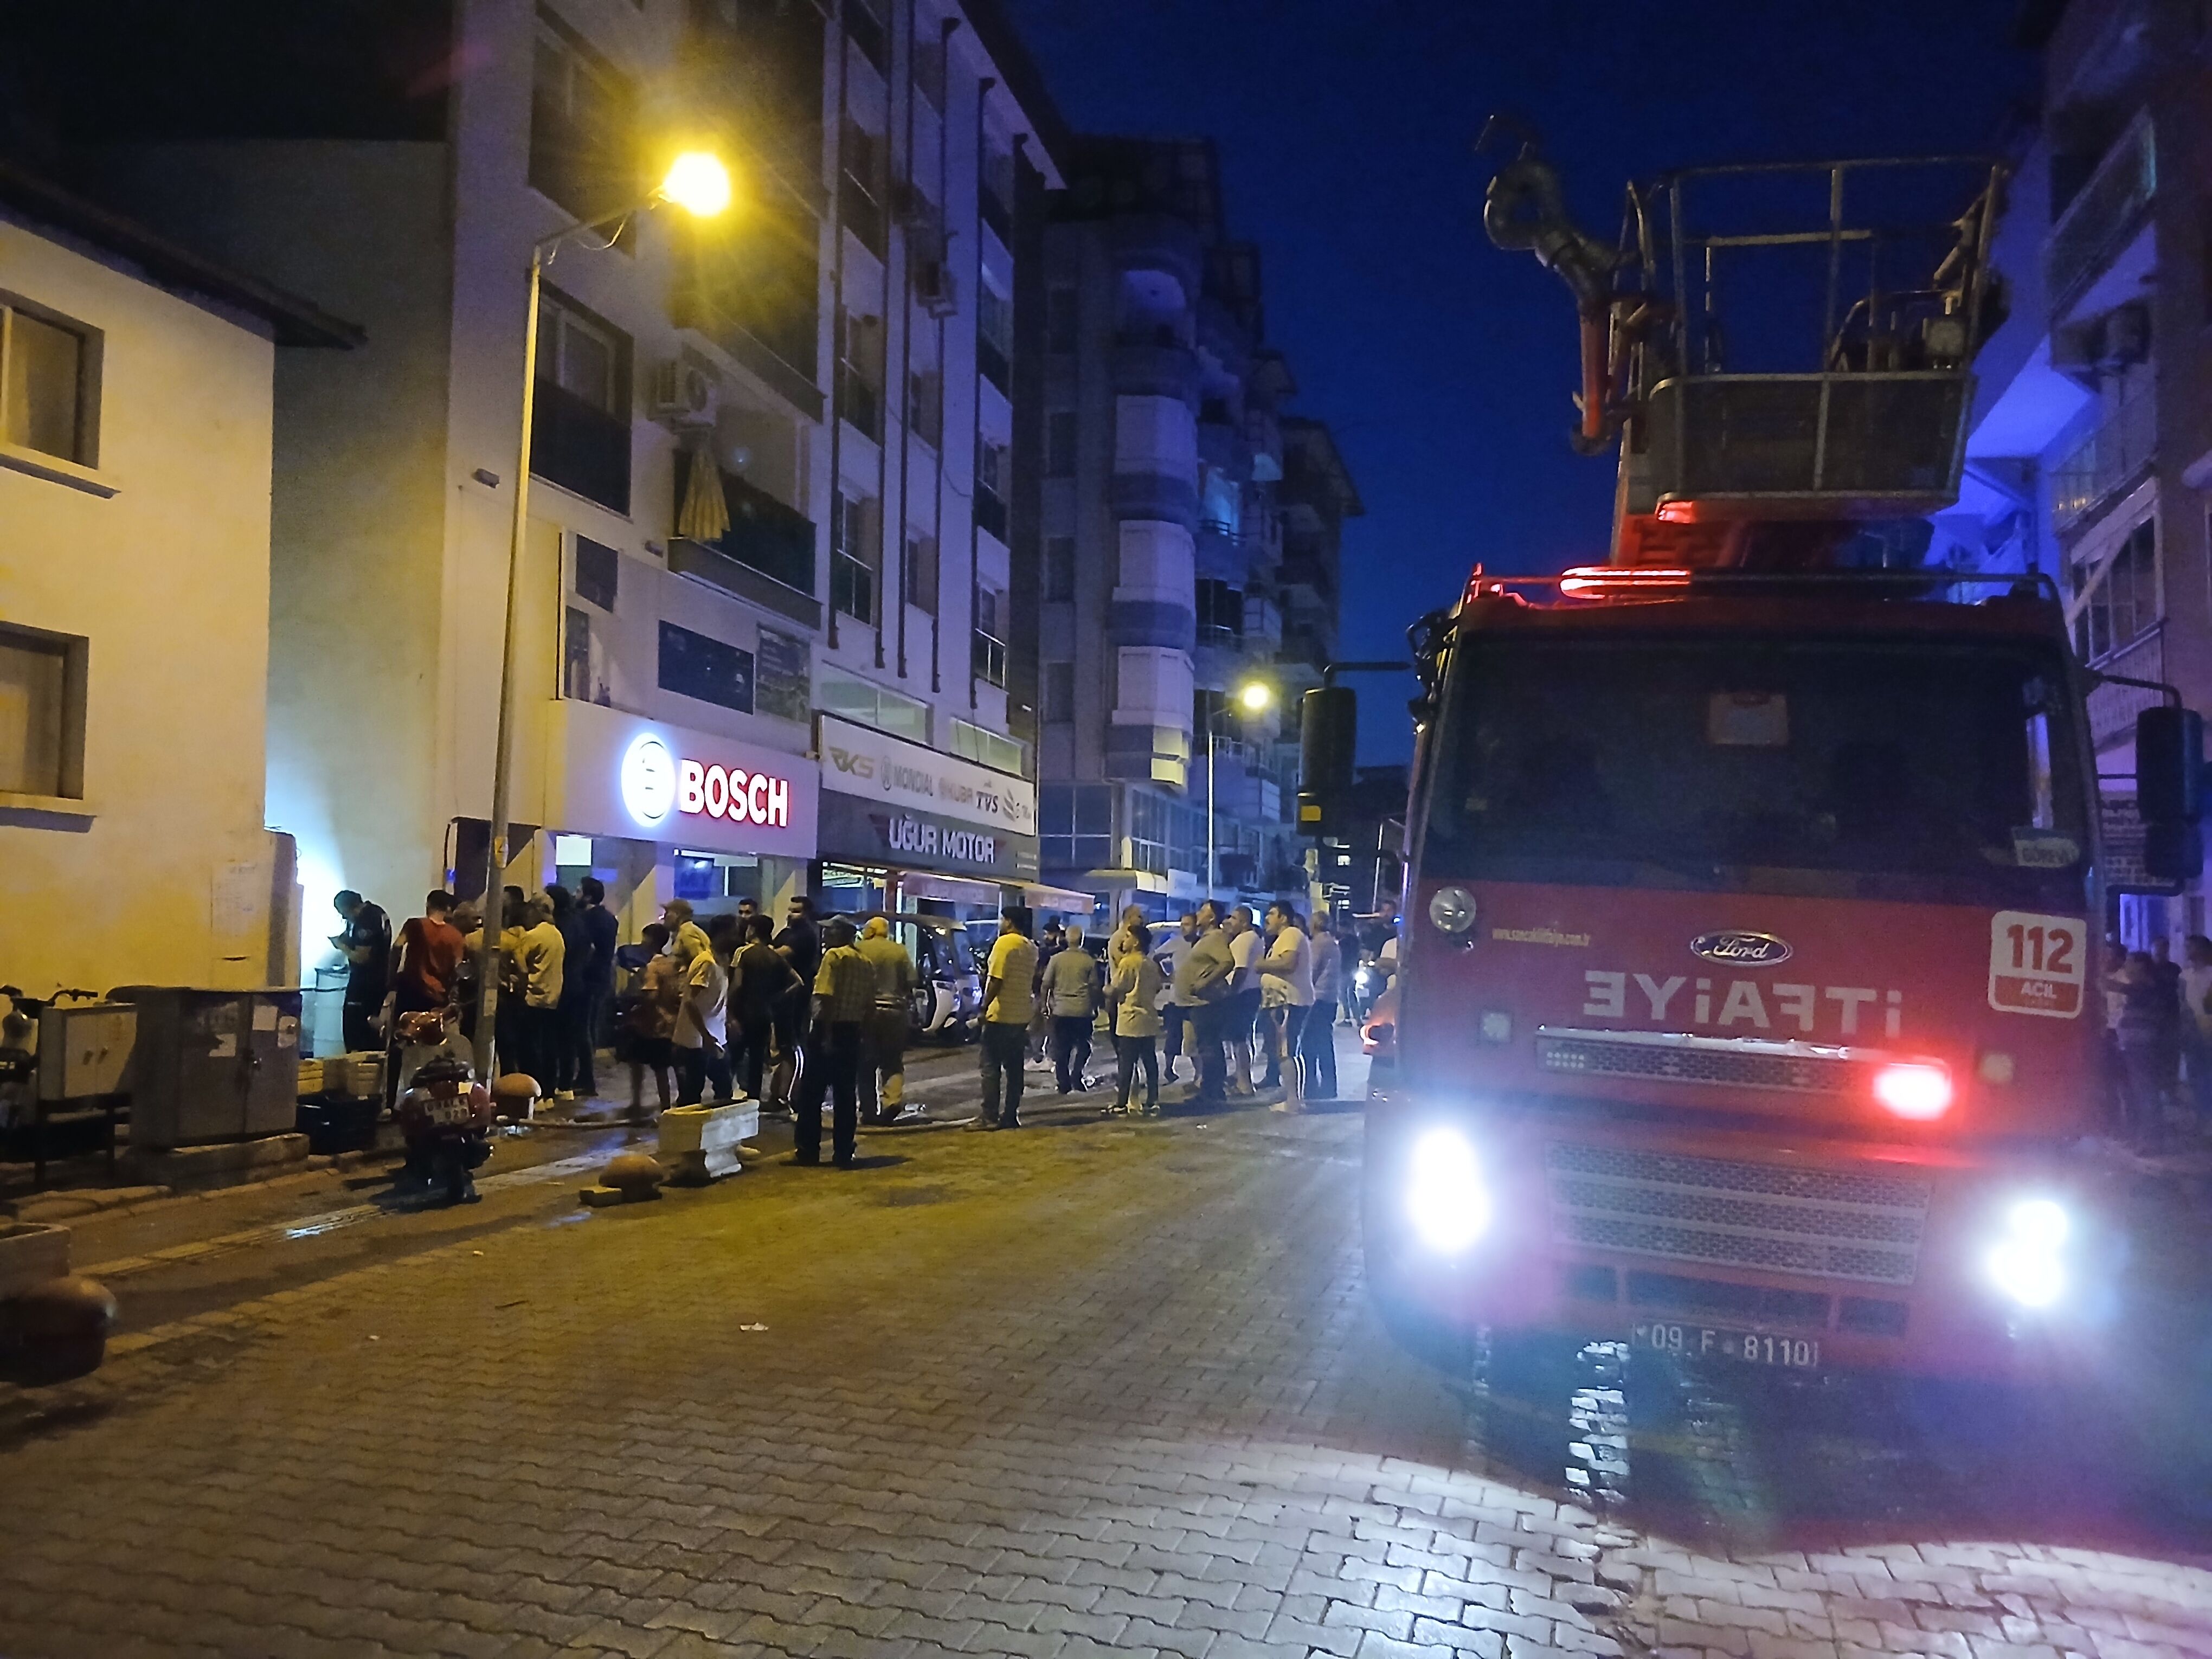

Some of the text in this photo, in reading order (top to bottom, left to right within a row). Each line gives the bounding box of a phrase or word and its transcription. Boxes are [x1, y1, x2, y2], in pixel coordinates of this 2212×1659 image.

[679, 758, 789, 828] BOSCH
[976, 790, 998, 813] TVS
[889, 814, 937, 855] UĞUR
[942, 828, 994, 864] MOTOR
[1713, 936, 1770, 959] Ford
[2007, 924, 2073, 974] 112
[1651, 1323, 1809, 1366] 09 F 8110
